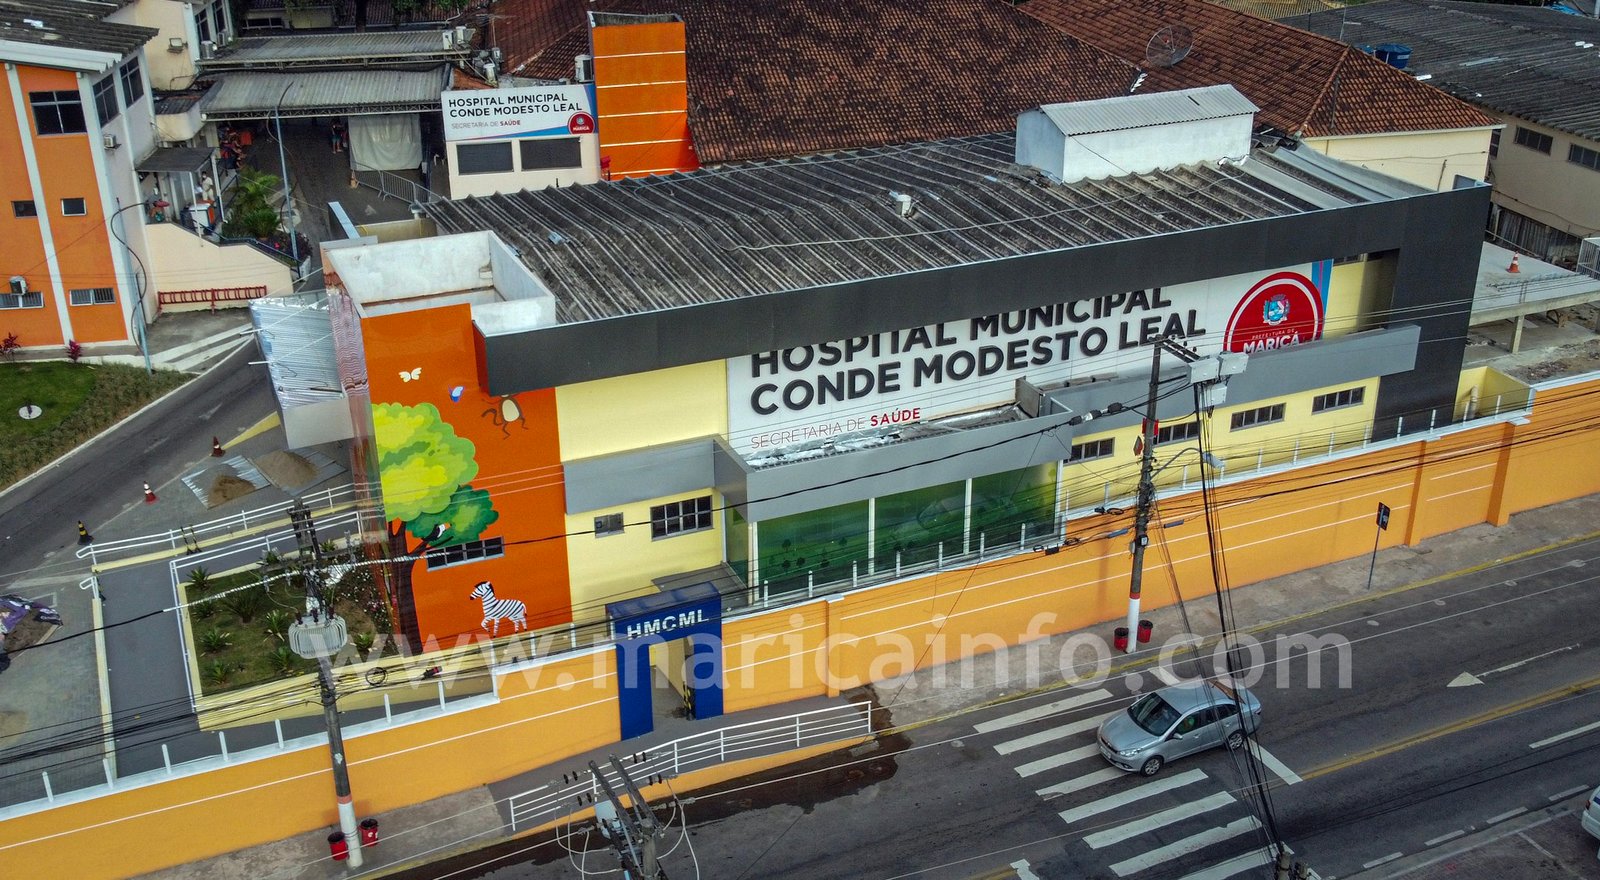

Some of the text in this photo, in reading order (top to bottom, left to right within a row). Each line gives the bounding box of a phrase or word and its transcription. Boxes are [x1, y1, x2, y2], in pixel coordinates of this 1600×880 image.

[449, 93, 568, 108] HOSPITAL MUNICIPAL
[450, 102, 582, 118] CONDE MODESTO LEAL
[451, 121, 489, 129] SECRETARIA
[500, 119, 521, 127] SAÚDE
[970, 287, 1172, 341] MUNICIPAL
[1242, 331, 1300, 354] MARICÁ
[1251, 330, 1286, 340] PREFEITURA
[750, 309, 1207, 416] CONDE MODESTO LEAL
[750, 408, 921, 449] SECRETARIA DE SAÚDE
[626, 609, 710, 641] HMCML
